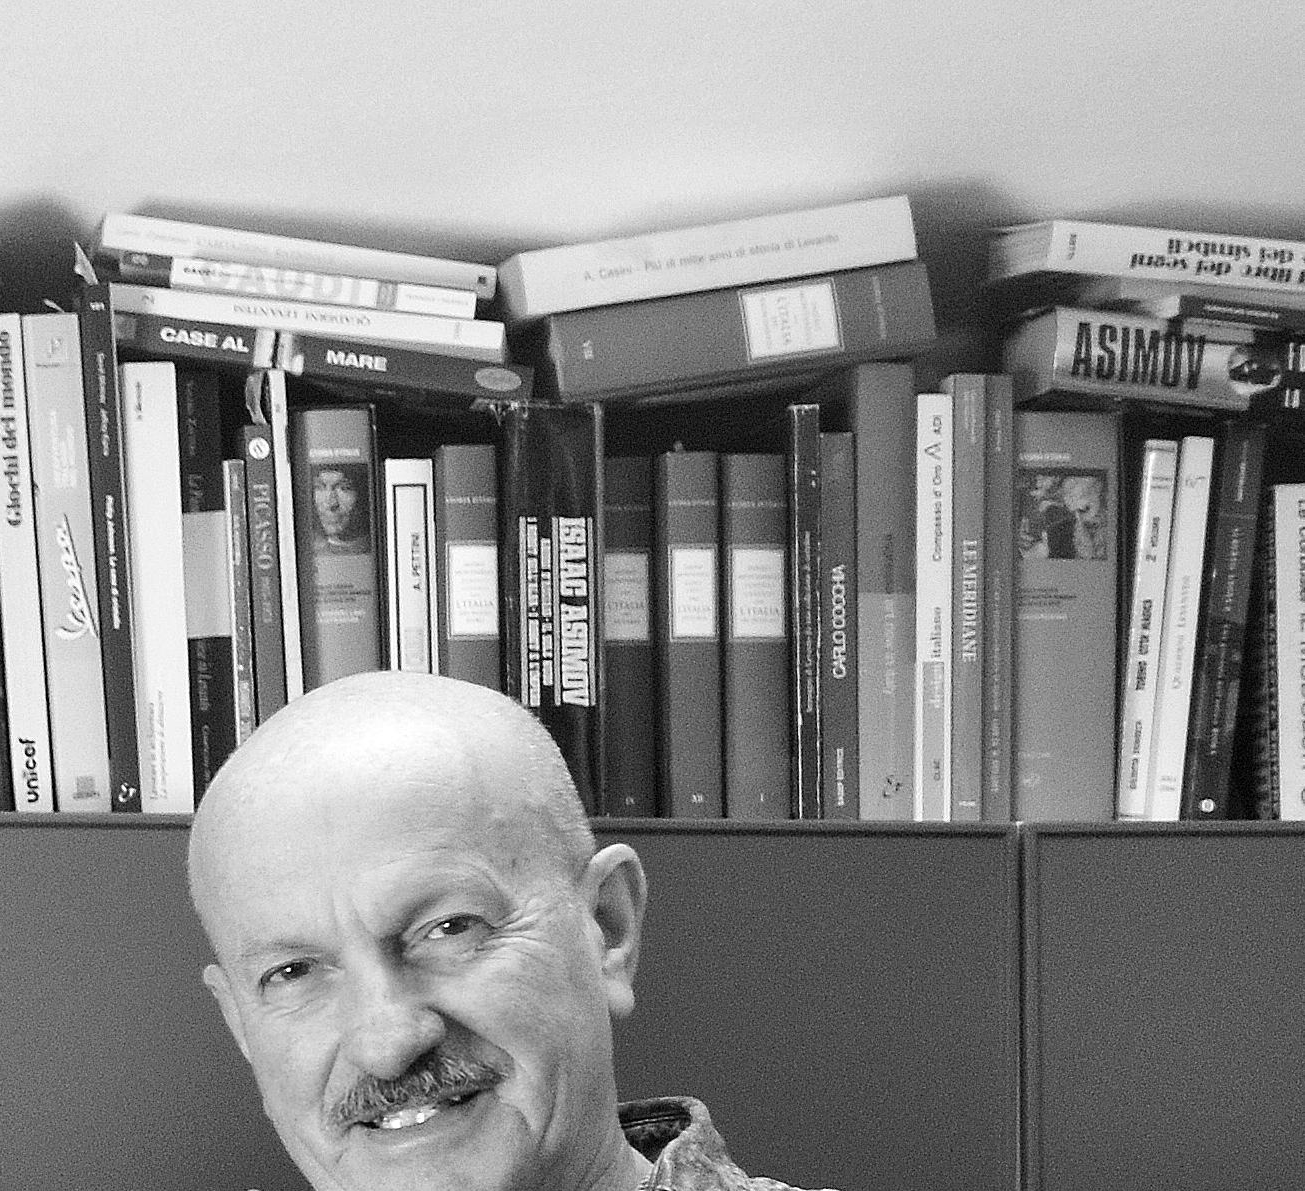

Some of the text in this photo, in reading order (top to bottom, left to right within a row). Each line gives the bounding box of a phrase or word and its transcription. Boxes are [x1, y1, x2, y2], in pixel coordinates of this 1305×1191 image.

[1130, 254, 1189, 271] segni
[1167, 239, 1295, 264] dei simboli
[1195, 260, 1233, 276] dei
[159, 327, 388, 372] CASE AL MARE
[1070, 322, 1206, 390] ASIMOV
[0, 416, 17, 449] del
[3, 455, 22, 527] Giochi
[252, 483, 274, 570] PICASSO
[559, 517, 589, 707] ISAAC ASIMOV
[831, 564, 846, 679] CARLO COCCHIA
[962, 540, 978, 663] LE MERIDIANE
[18, 737, 40, 803] unicef
